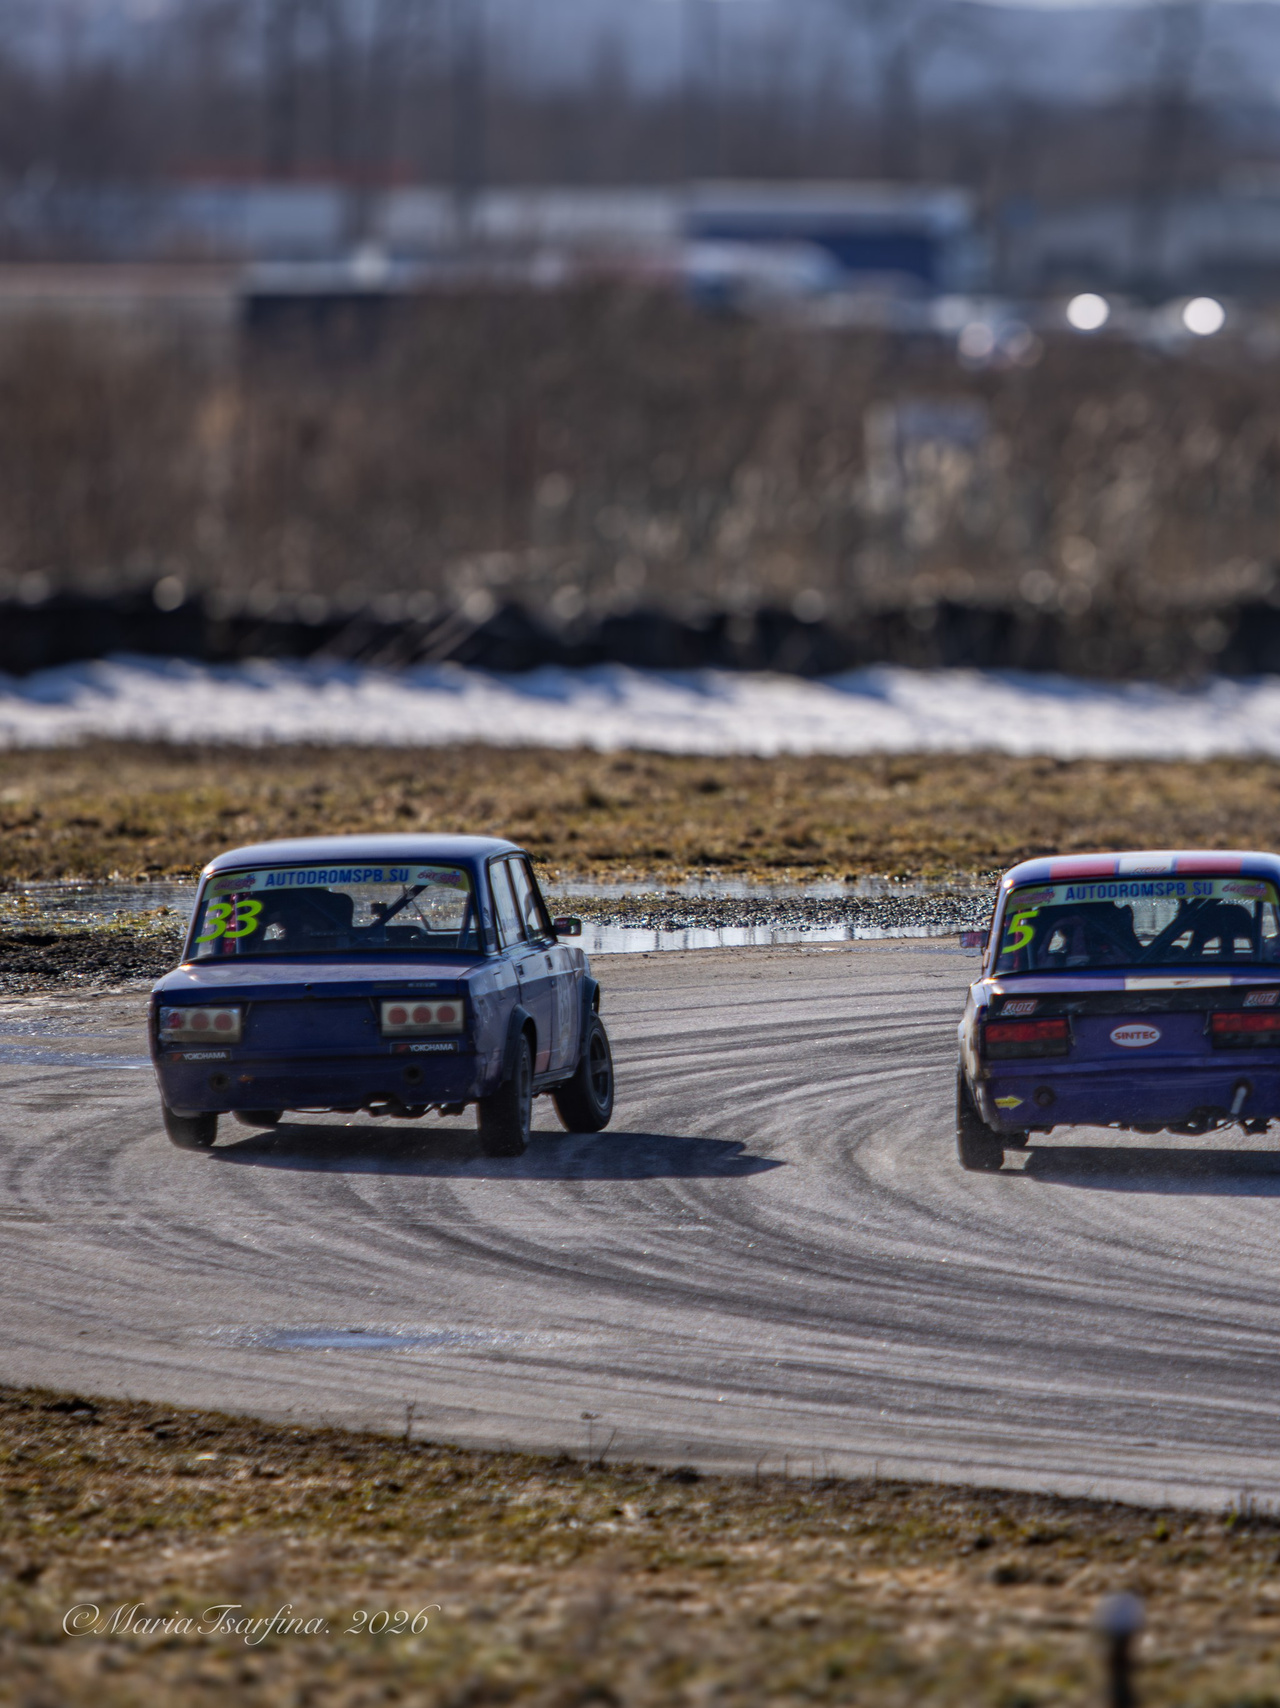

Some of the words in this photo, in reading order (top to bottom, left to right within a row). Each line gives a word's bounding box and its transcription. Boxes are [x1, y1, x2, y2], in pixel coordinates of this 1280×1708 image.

[265, 868, 410, 888] AUTODROMSPB.SU
[1065, 881, 1213, 901] AUTODROMSPB.SU
[195, 899, 265, 944] 33
[1001, 909, 1039, 954] 5
[1247, 993, 1277, 1003] KLOTZ
[1005, 1001, 1035, 1012] KLOTZ
[1114, 1031, 1157, 1041] SINTEC
[409, 1043, 454, 1052] YOKOHAMA
[182, 1051, 227, 1061] YOKOHAMA
